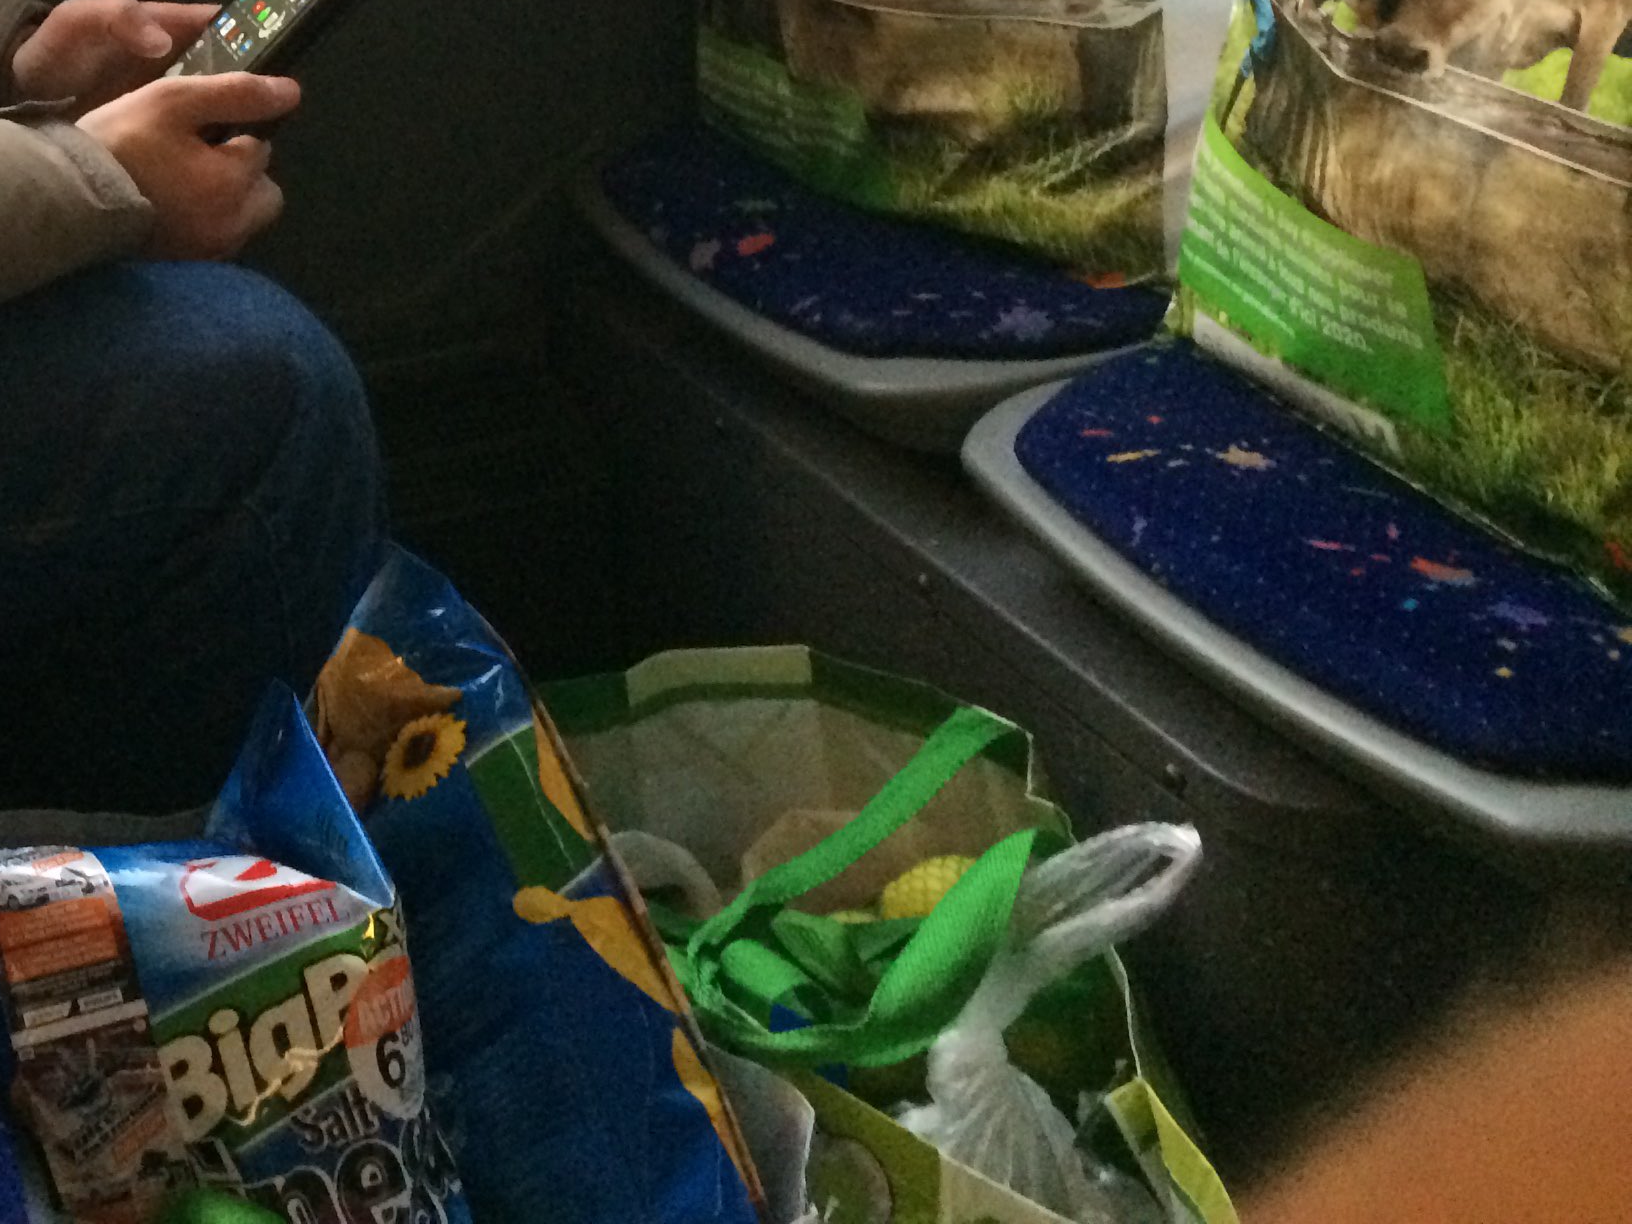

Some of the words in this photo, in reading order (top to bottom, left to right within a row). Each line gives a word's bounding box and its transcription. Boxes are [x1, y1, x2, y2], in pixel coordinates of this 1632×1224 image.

[198, 896, 352, 961] ZWEIFEL
[375, 1030, 407, 1089] 6
[292, 1088, 379, 1154] Salt
